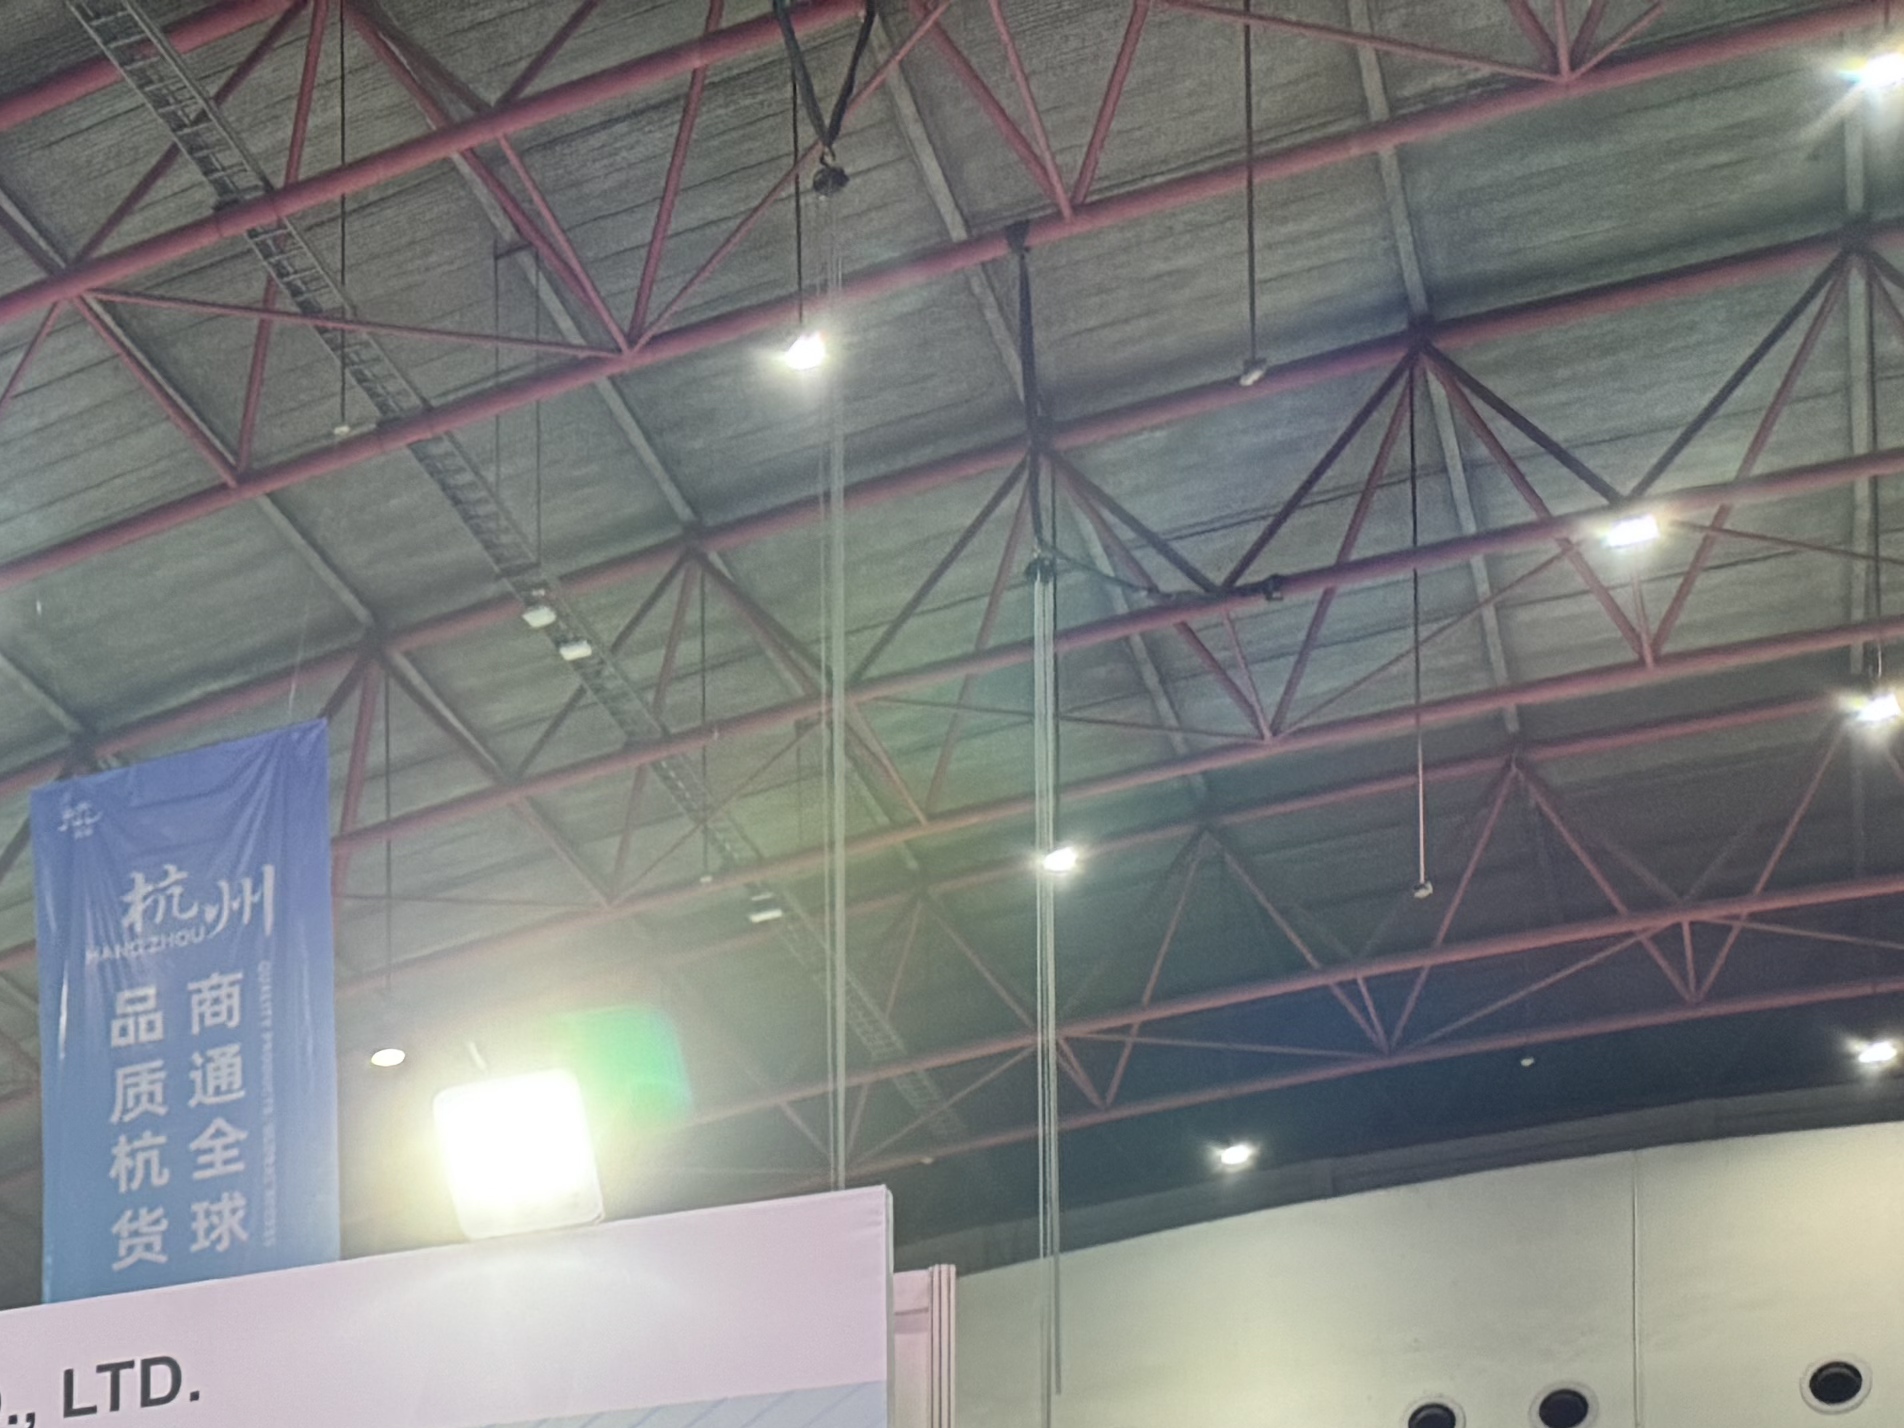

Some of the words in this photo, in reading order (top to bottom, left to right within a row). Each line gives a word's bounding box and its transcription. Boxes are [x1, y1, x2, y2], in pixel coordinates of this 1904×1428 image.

[120, 864, 275, 937] 杭州
[86, 925, 206, 965] HANGZHOU
[108, 984, 169, 1272] 品质杭货
[187, 970, 249, 1255] 商通全球
[62, 1352, 202, 1420] LTD.
